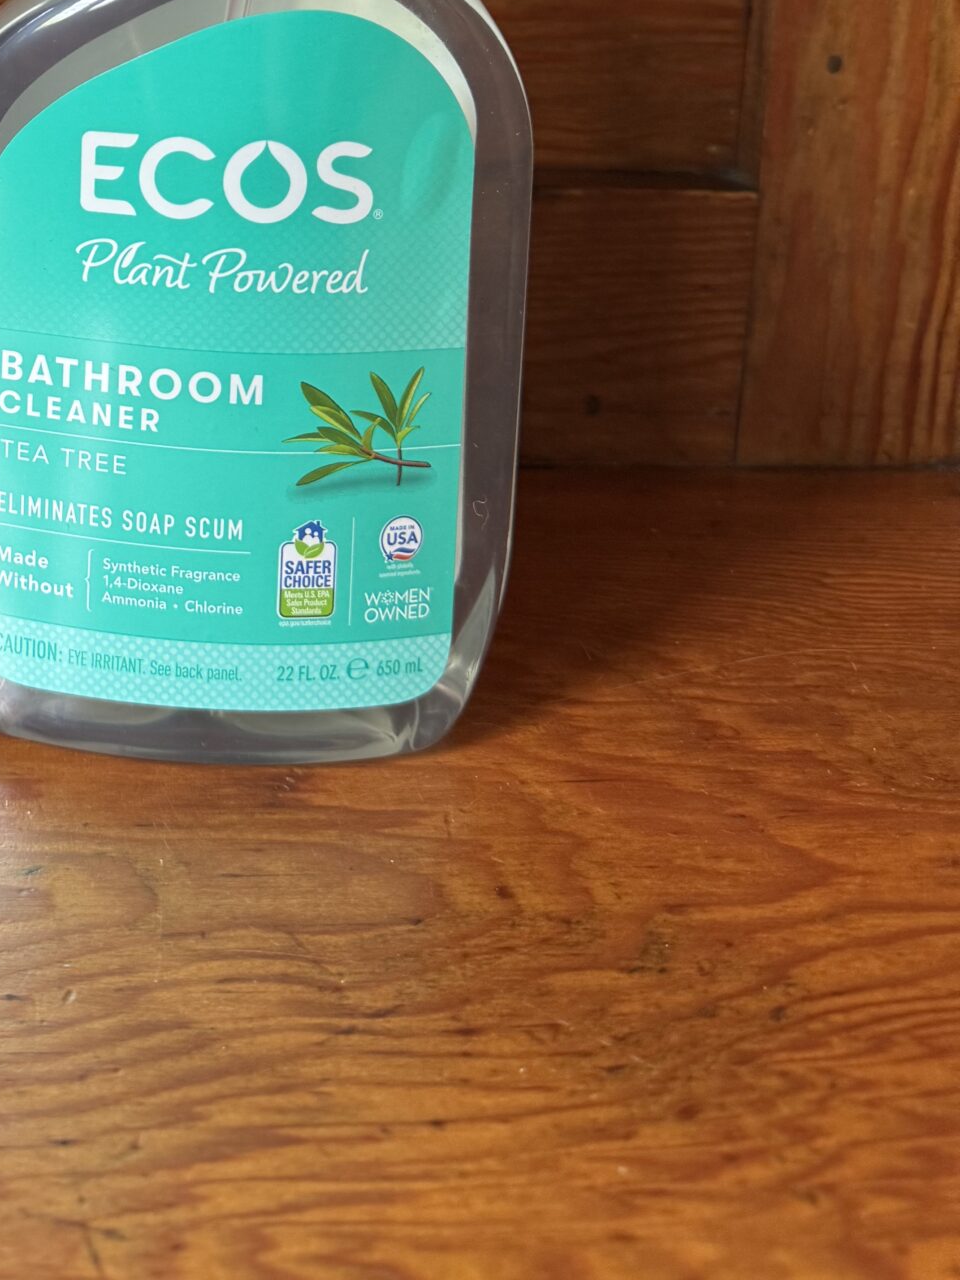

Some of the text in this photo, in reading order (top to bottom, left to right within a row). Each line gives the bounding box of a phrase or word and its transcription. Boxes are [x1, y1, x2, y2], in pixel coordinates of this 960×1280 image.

[75, 237, 371, 294] Plant Powered
[0, 349, 263, 406] BATHROOM
[0, 438, 127, 476] TEA TREE
[122, 509, 175, 536] SOAP
[184, 516, 243, 542] SCUM
[386, 530, 418, 546] USA
[102, 557, 241, 583] Synthetic Fragrance
[285, 559, 332, 575] SAFER
[284, 574, 332, 588] CHOICE
[101, 591, 244, 616] Ammonia Chlorine
[364, 602, 430, 624] OWNED
[67, 647, 88, 667] EYE
[91, 651, 146, 676] IRRITANT.
[149, 659, 172, 677] See
[174, 661, 204, 680] back
[206, 665, 242, 684] panel.
[276, 665, 295, 682] 22
[297, 665, 316, 682] FL.
[319, 663, 340, 680] OZ.
[376, 659, 401, 676] 650
[404, 657, 424, 674] mL
